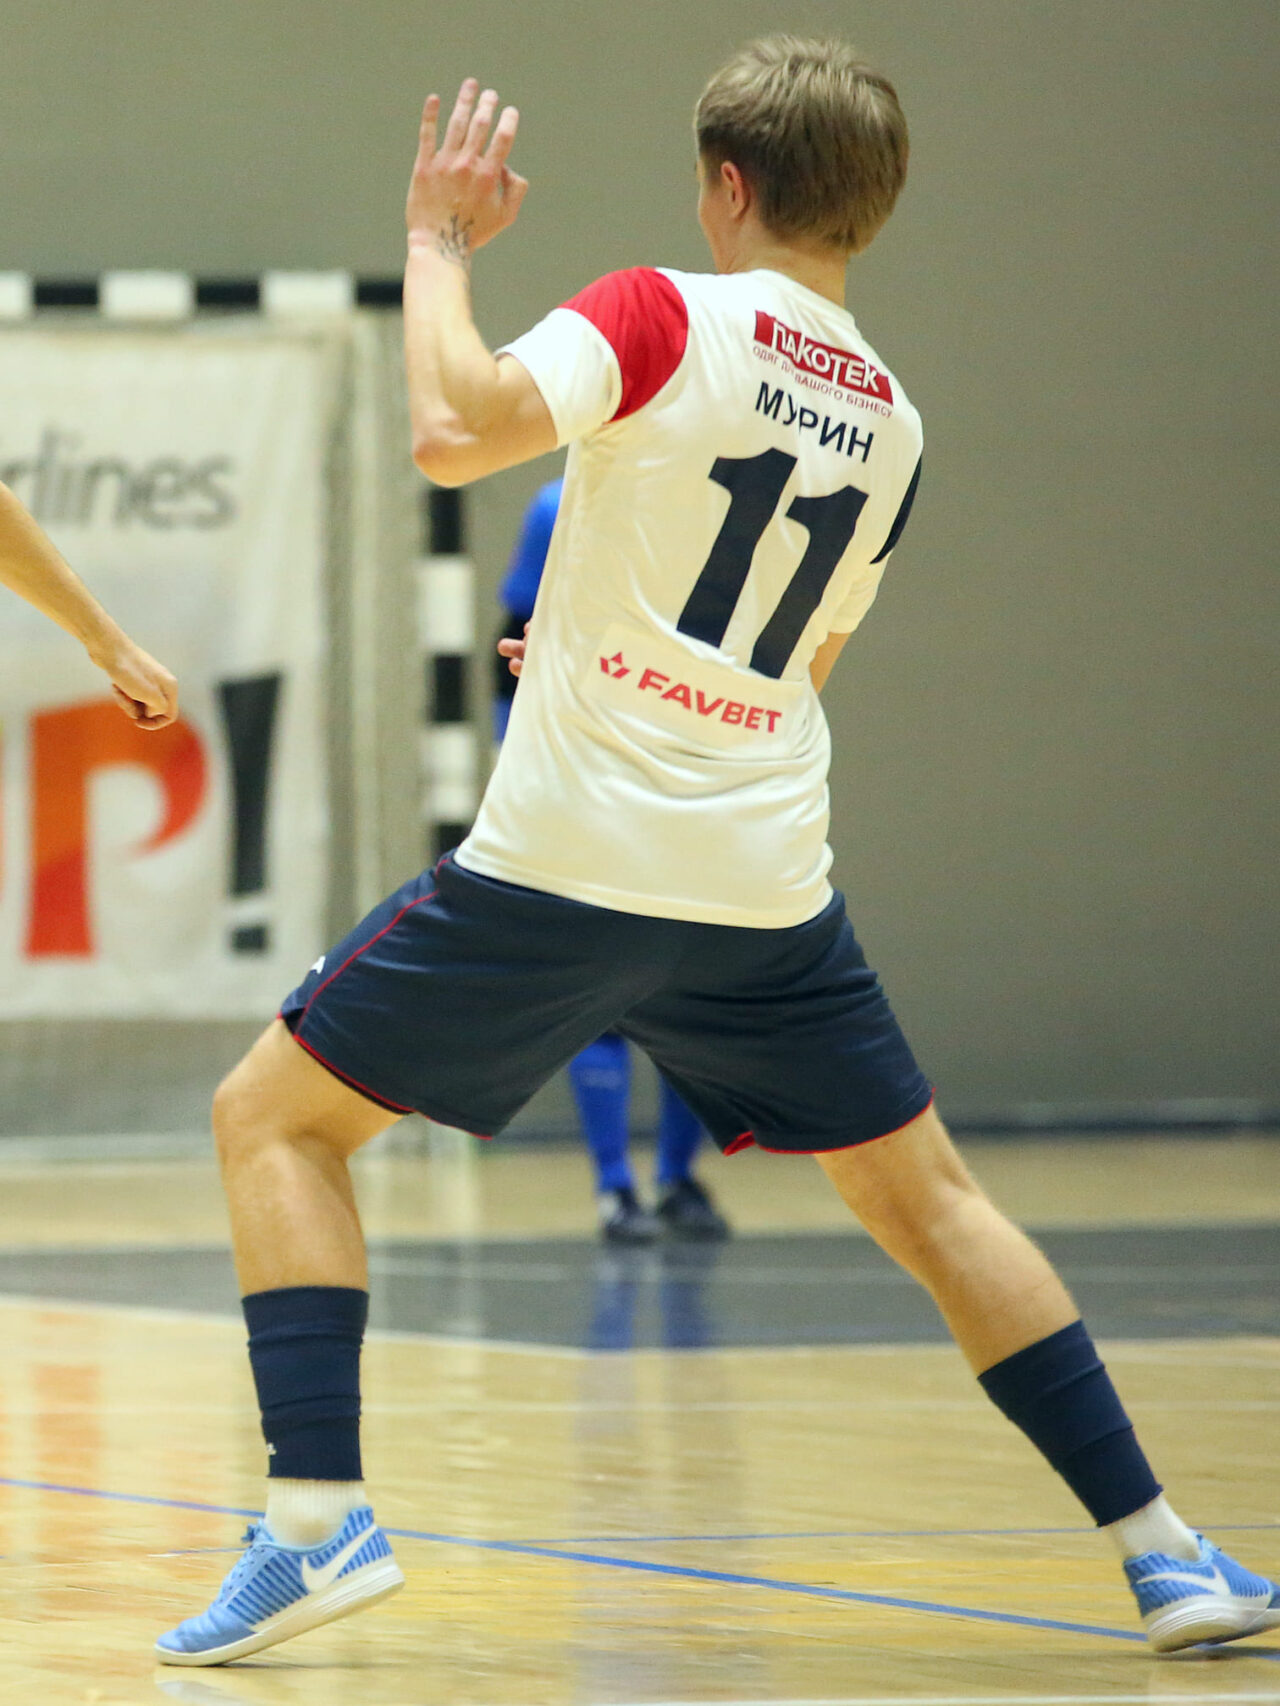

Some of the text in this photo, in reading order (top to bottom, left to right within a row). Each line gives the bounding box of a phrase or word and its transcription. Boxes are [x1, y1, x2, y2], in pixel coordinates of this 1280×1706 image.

[770, 320, 880, 393] ПАКОТЕК
[755, 381, 874, 463] МУРИН
[676, 447, 869, 679] 11
[638, 668, 782, 734] FAVBET
